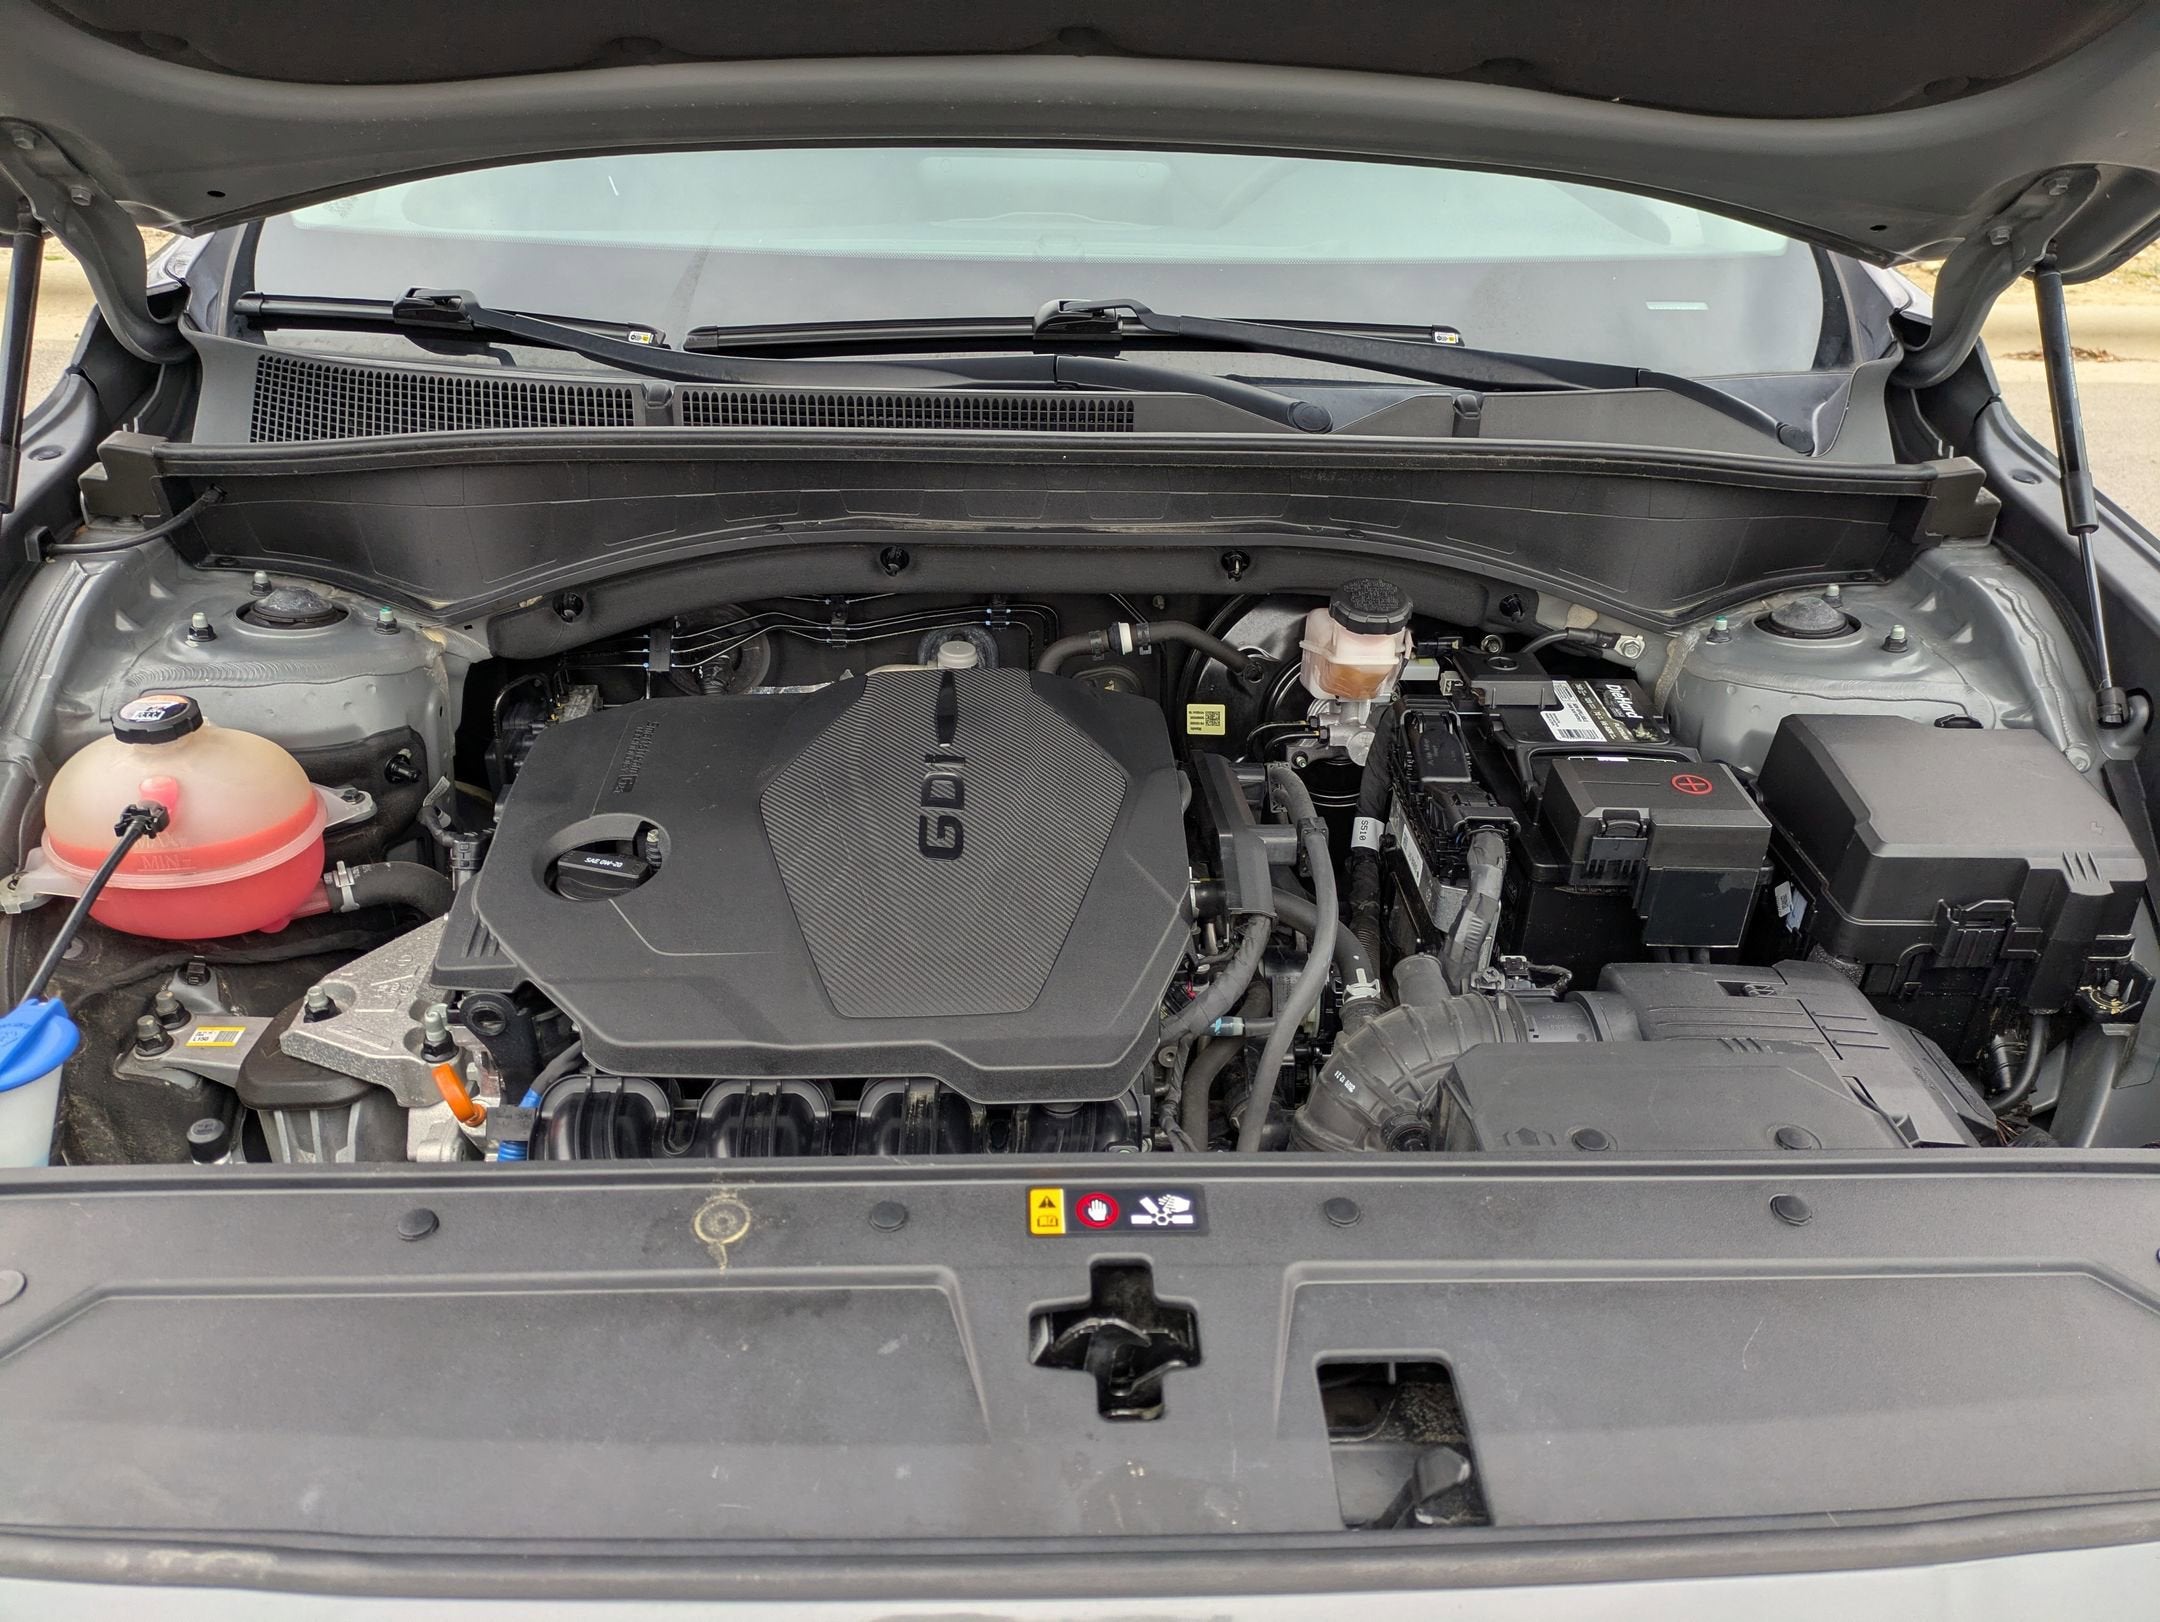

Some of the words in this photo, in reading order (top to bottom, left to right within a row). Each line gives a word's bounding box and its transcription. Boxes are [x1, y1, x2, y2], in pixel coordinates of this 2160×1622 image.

[1606, 684, 1643, 719] DieHard
[1358, 819, 1369, 841] S510
[584, 857, 600, 865] SAE
